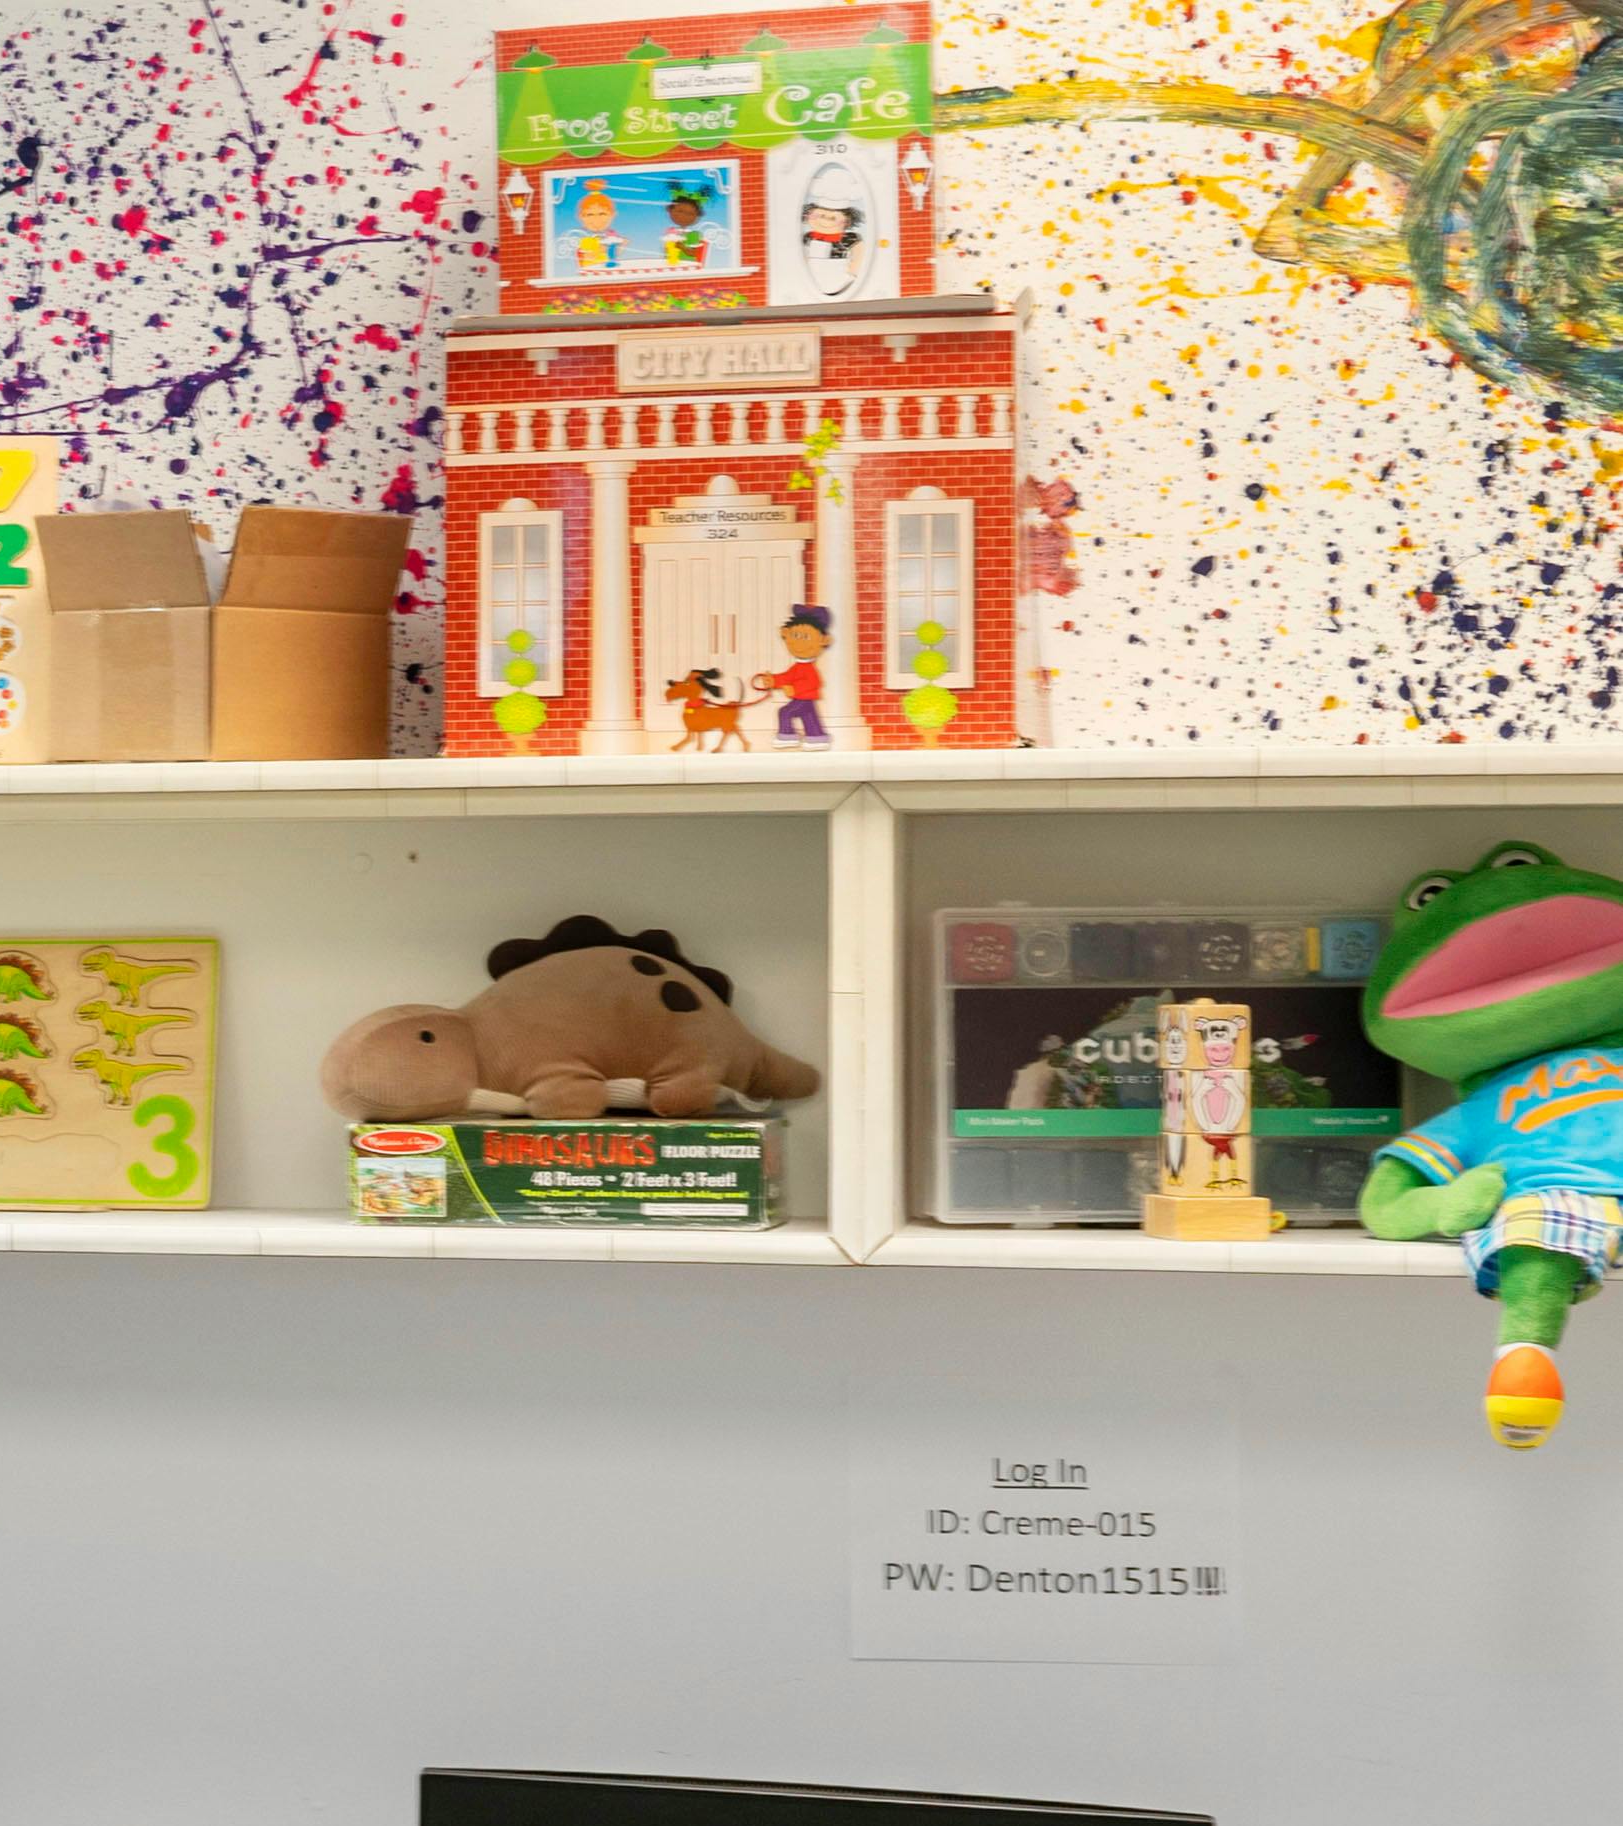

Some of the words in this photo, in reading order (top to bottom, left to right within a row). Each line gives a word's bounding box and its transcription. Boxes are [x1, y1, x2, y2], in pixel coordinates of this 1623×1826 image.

[525, 112, 615, 144] Frog
[622, 103, 738, 135] Street
[763, 77, 911, 127] Cafe
[634, 346, 712, 379] CITY
[719, 341, 811, 376] HALL
[659, 510, 714, 523] Teacher
[717, 508, 788, 522] Resources
[706, 528, 738, 539] 324
[126, 1094, 199, 1198] 3
[483, 1130, 657, 1168] DINOSAURS
[660, 1145, 708, 1159] FLOOR
[710, 1146, 761, 1159] PUZZLE
[531, 1171, 554, 1186] 48
[555, 1172, 602, 1187] Pieces
[620, 1172, 634, 1187] 2
[635, 1172, 669, 1187] Feet
[682, 1172, 695, 1187] 3
[697, 1172, 737, 1187] Feet!
[992, 1458, 1049, 1487] Log
[1059, 1459, 1088, 1484] In
[926, 1510, 970, 1534] ID:
[981, 1510, 1156, 1537] Creme-015
[882, 1563, 955, 1592] PW:
